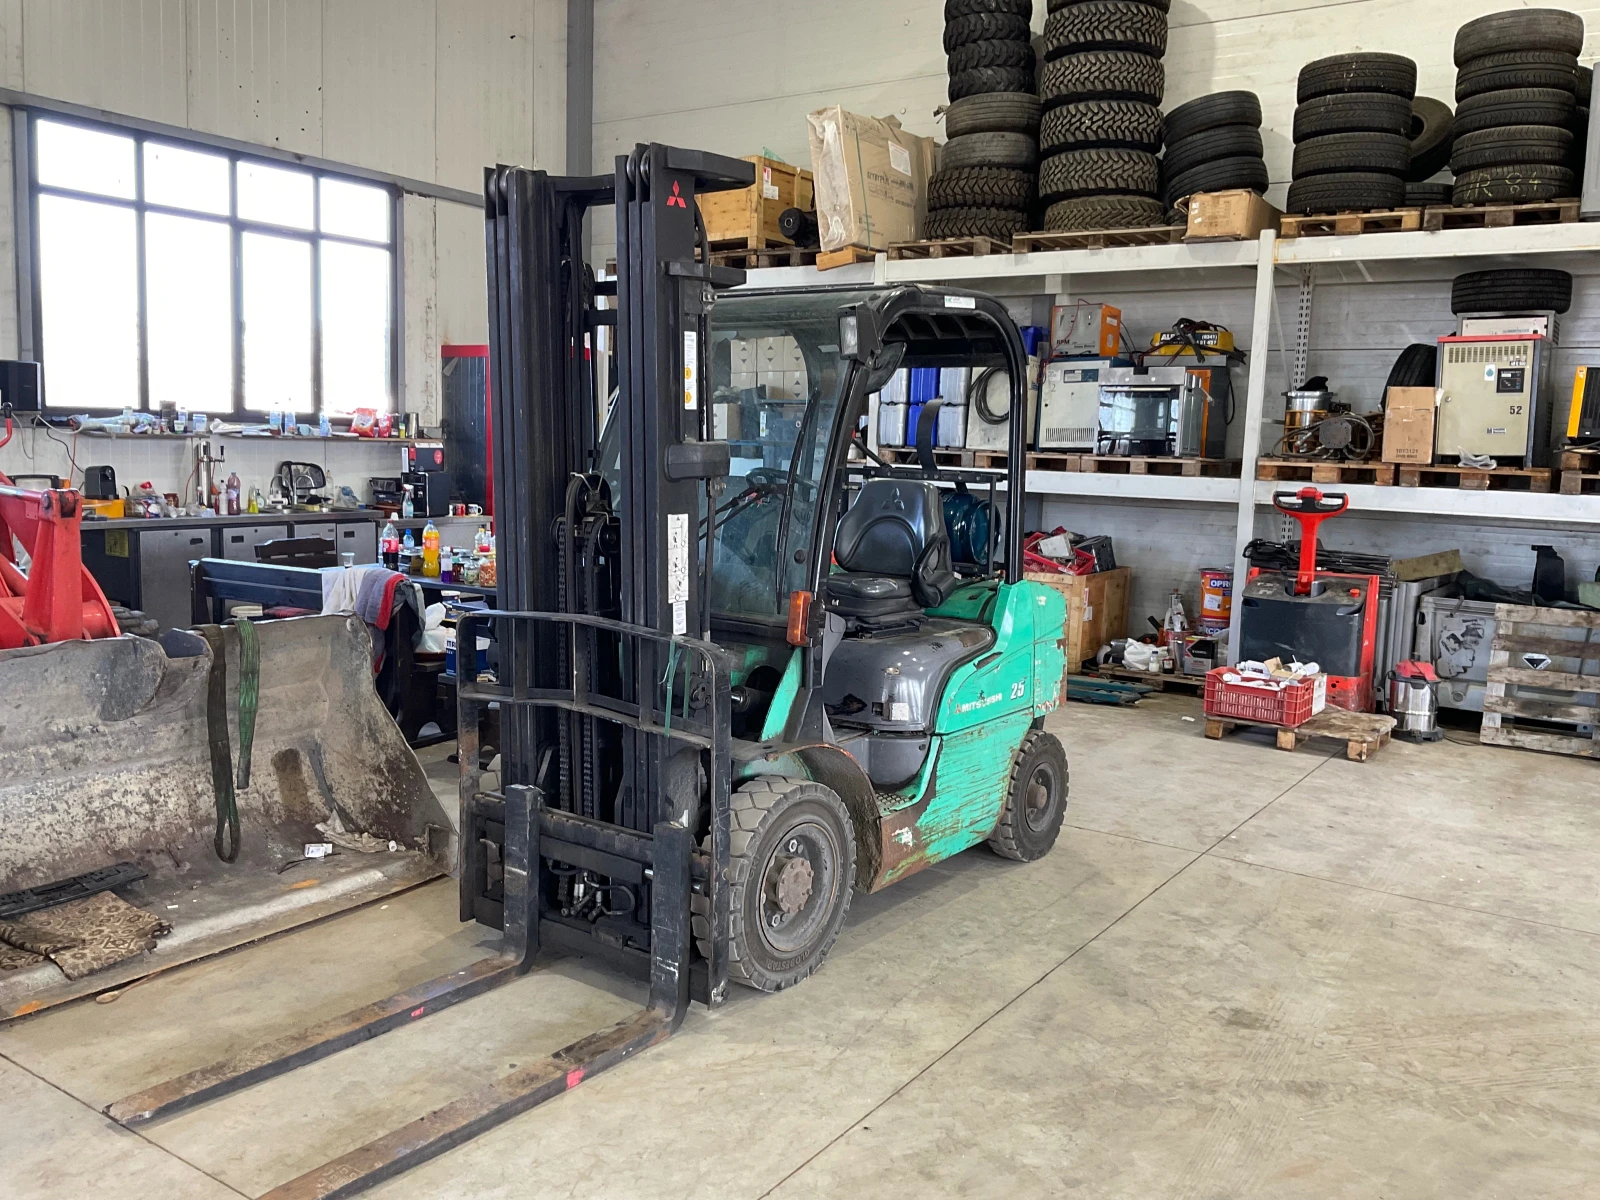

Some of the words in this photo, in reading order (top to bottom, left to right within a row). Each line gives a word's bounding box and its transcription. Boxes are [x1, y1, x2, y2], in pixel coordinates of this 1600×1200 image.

[1509, 405, 1523, 415] 52
[1210, 580, 1231, 588] OPR
[1010, 679, 1026, 700] 25
